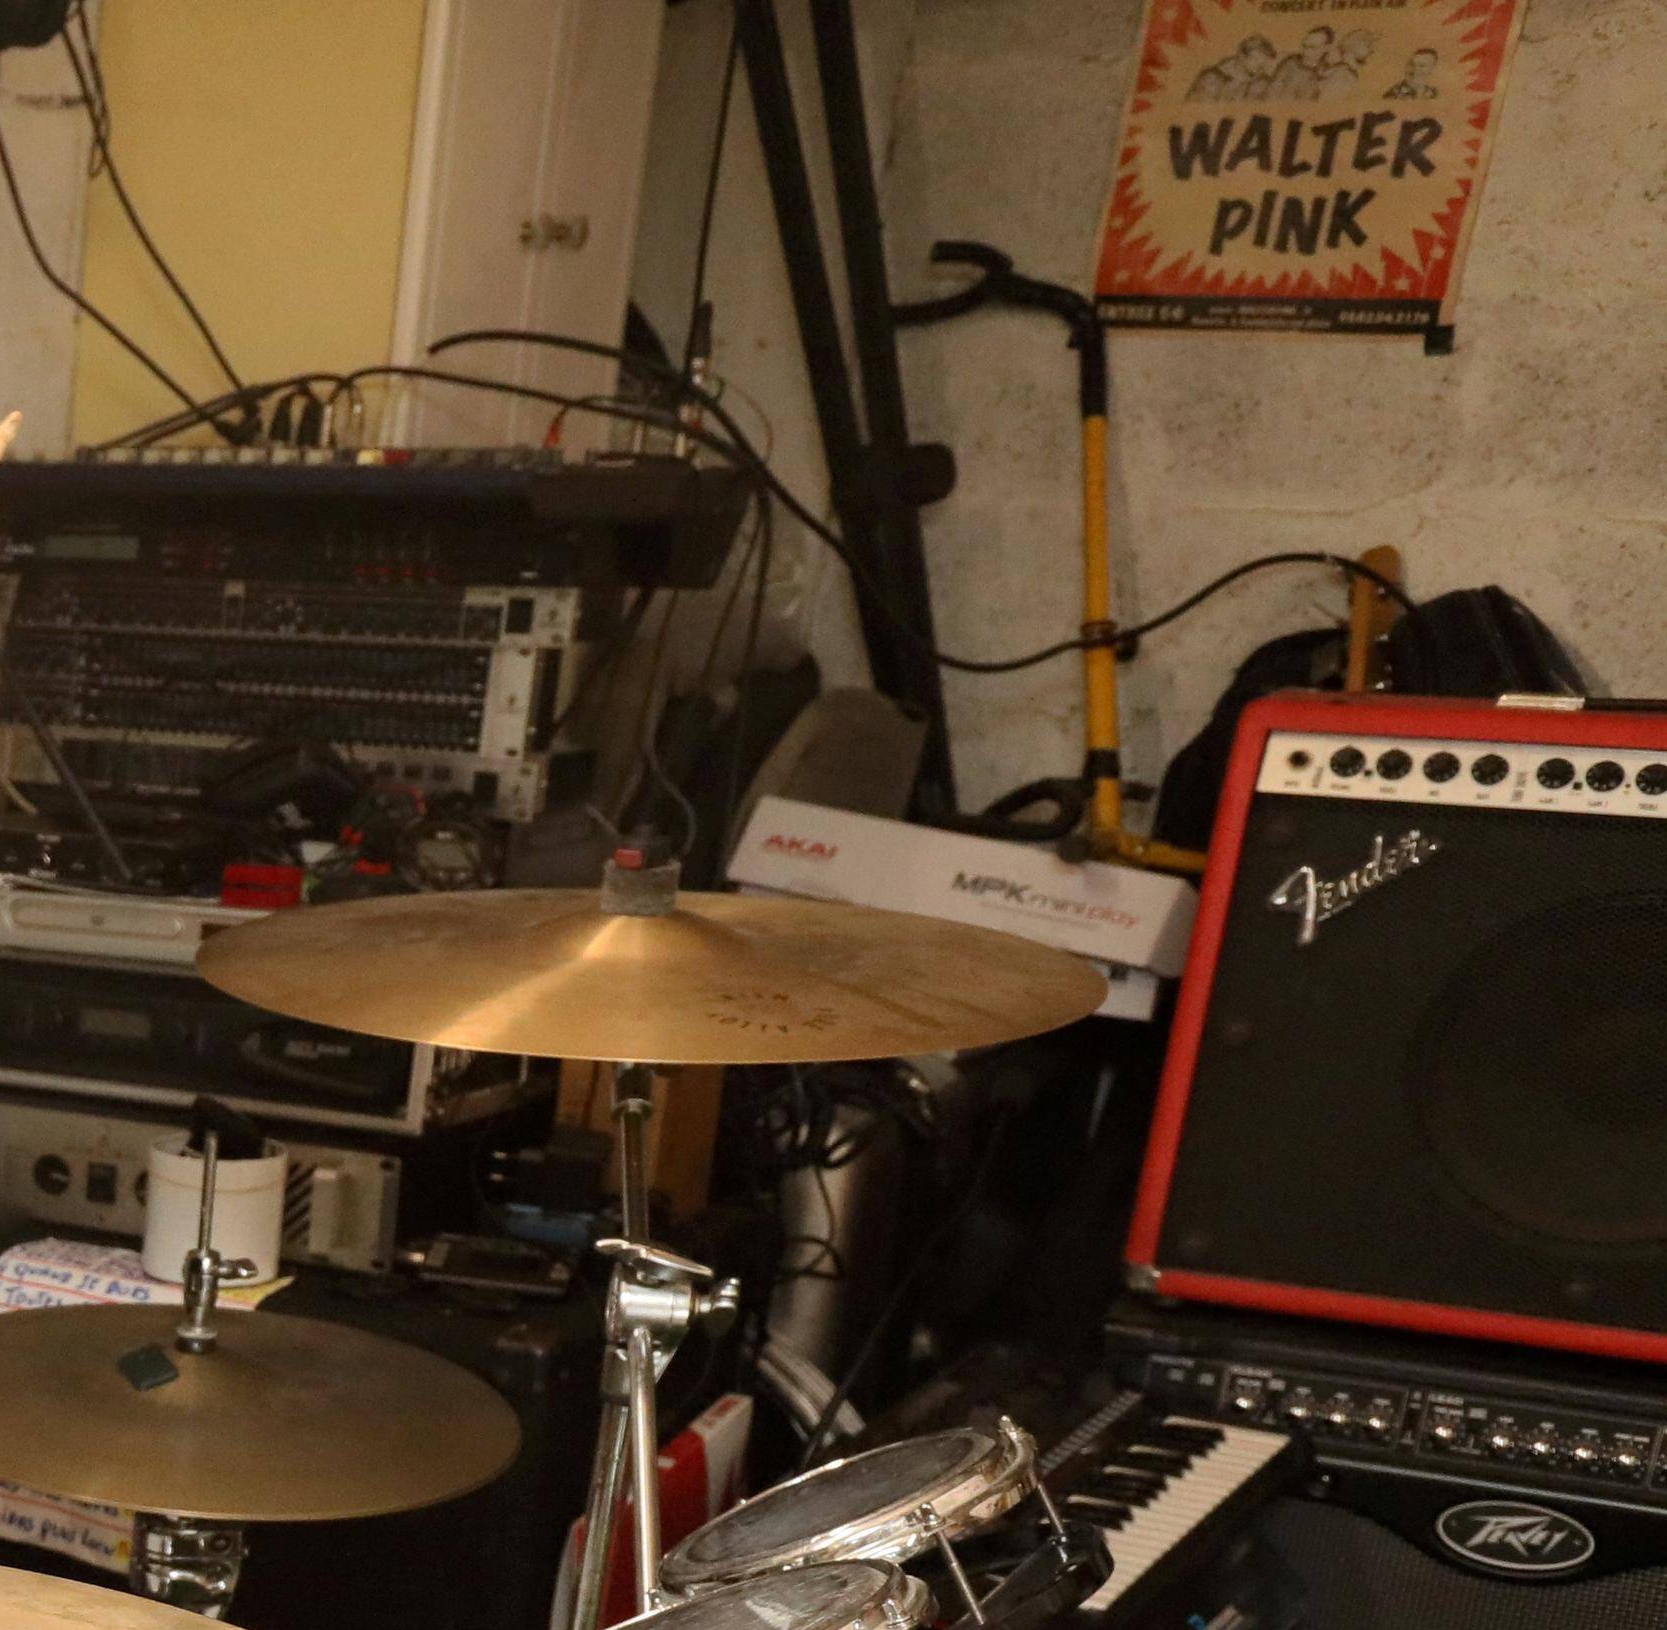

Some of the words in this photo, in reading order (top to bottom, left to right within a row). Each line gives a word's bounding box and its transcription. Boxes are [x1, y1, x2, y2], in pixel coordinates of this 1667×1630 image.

[1168, 109, 1443, 181] WALTER
[1209, 189, 1377, 256] PINK
[763, 833, 839, 861] AKAI
[1271, 829, 1441, 946] Fender
